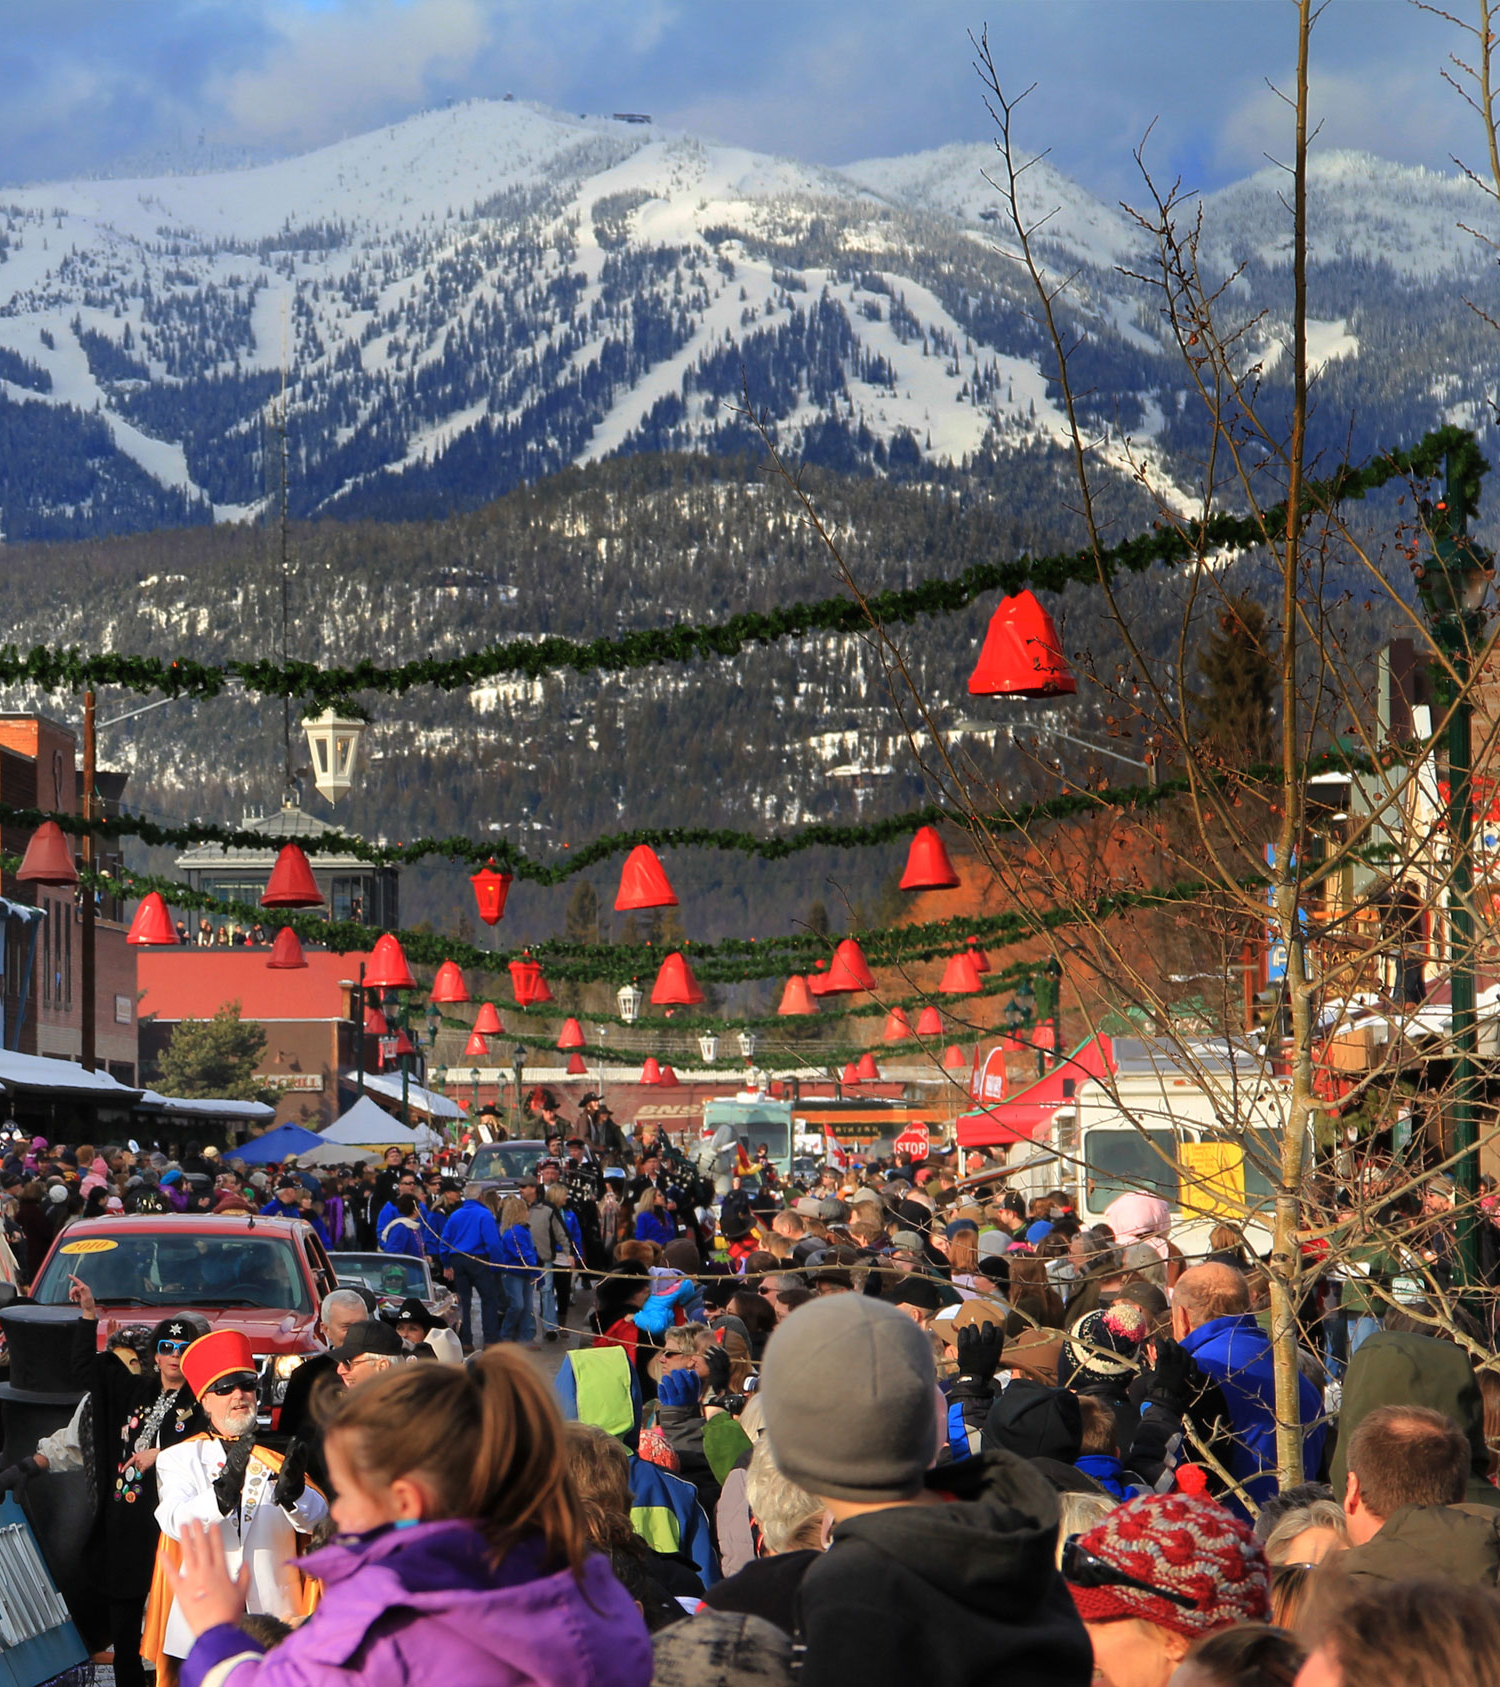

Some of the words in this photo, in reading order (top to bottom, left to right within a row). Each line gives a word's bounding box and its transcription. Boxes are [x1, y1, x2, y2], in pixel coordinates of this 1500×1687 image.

[637, 1104, 704, 1115] BNS
[817, 1126, 878, 1134] NRTHERN
[897, 1142, 926, 1155] STOP
[67, 1241, 109, 1251] 2010
